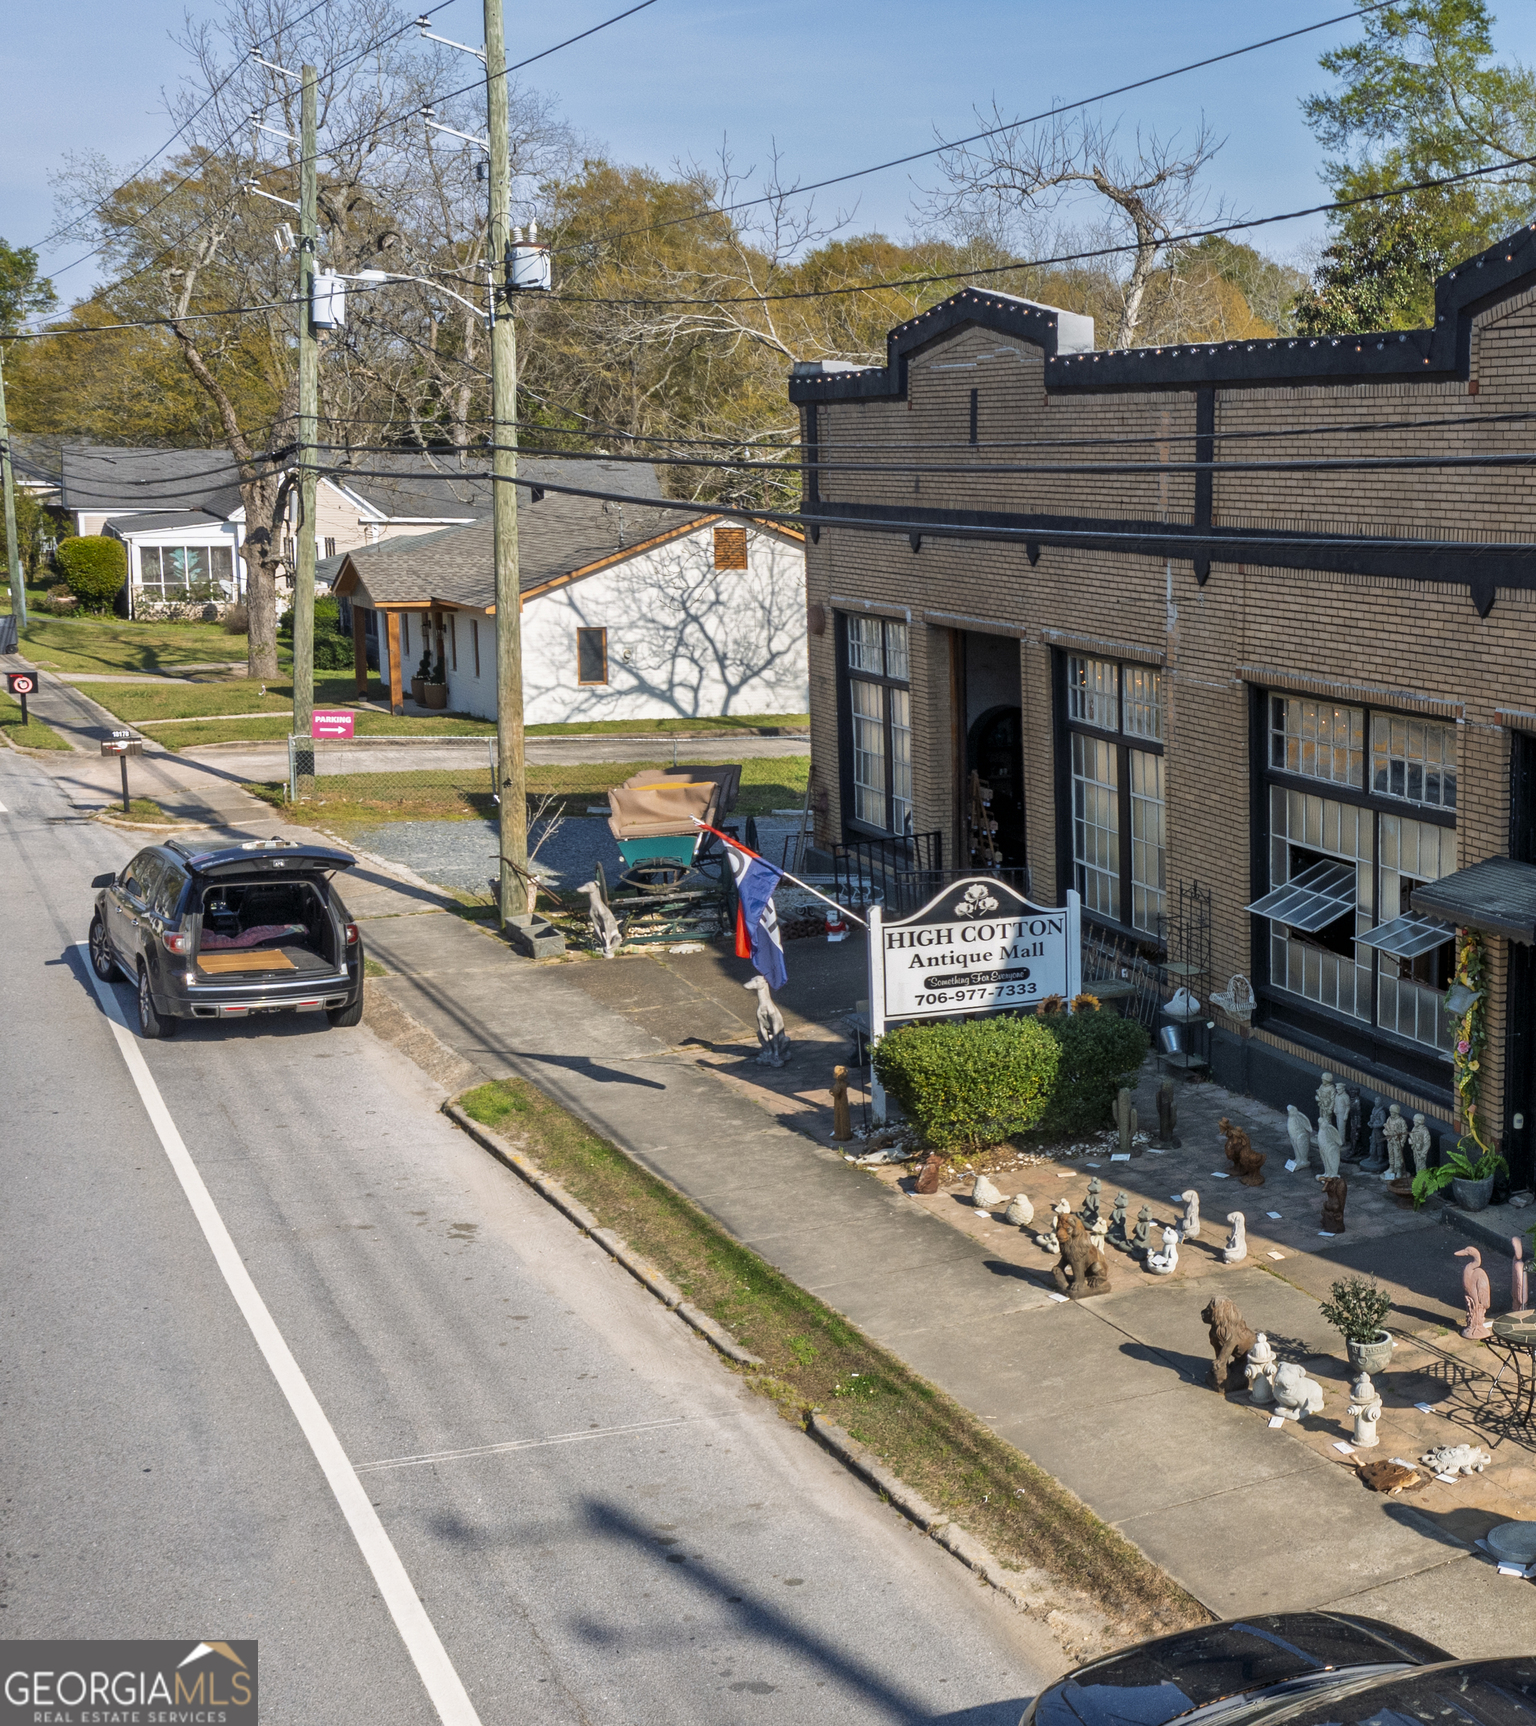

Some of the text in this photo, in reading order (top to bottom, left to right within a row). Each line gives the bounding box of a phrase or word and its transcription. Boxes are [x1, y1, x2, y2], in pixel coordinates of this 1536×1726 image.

[886, 918, 1063, 949] HIGH COTTON
[908, 942, 1044, 969] Antique Mall
[971, 972, 989, 984] For
[915, 983, 1037, 1006] 706-977-7333
